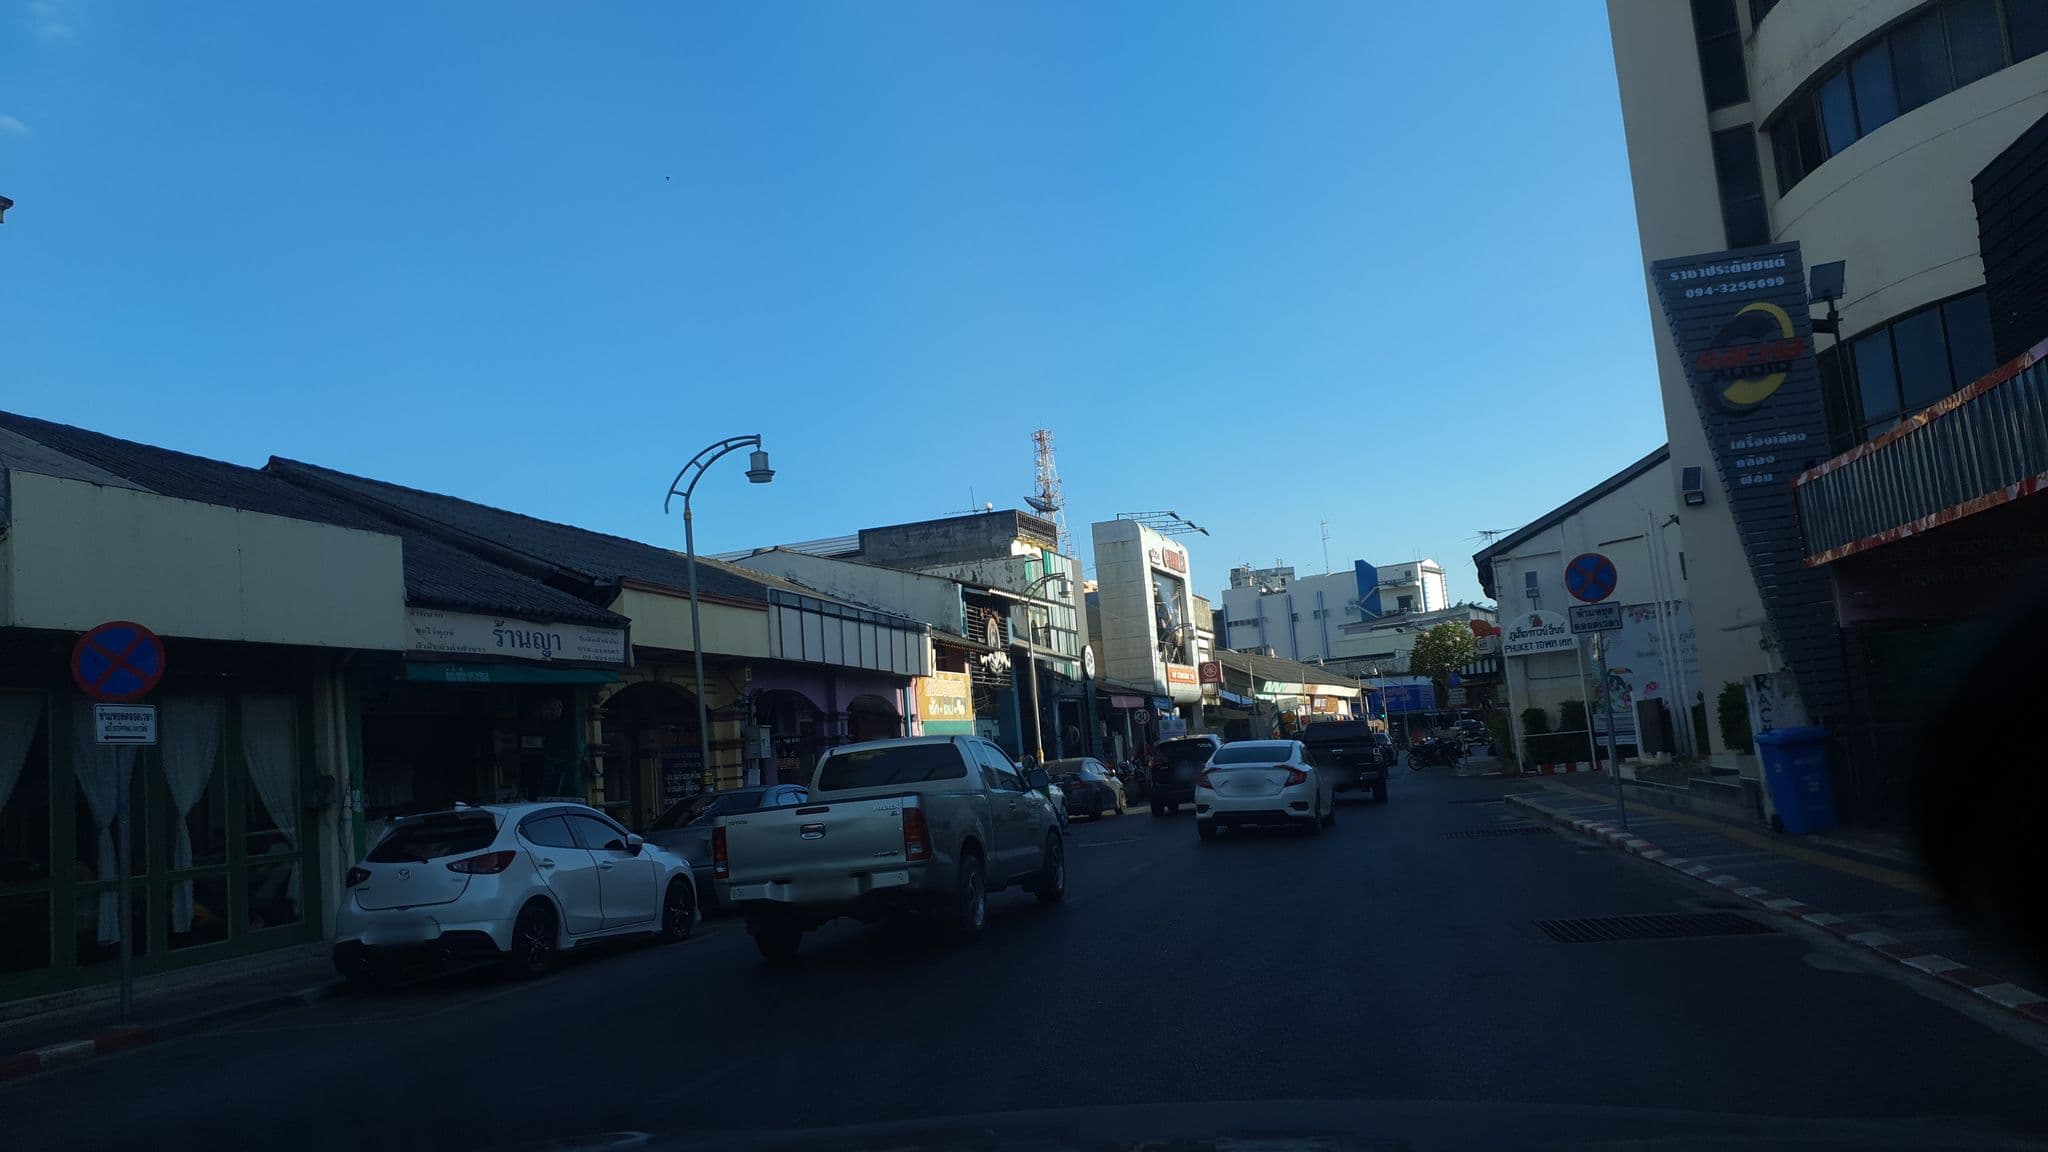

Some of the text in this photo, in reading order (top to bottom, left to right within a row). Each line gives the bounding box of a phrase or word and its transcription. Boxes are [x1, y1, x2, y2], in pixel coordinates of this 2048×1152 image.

[1685, 276, 1786, 298] 094-3256699
[492, 618, 562, 657] ร้านญา
[1504, 637, 1573, 653] PHUKET TOWN INN
[1135, 711, 1149, 723] 30
